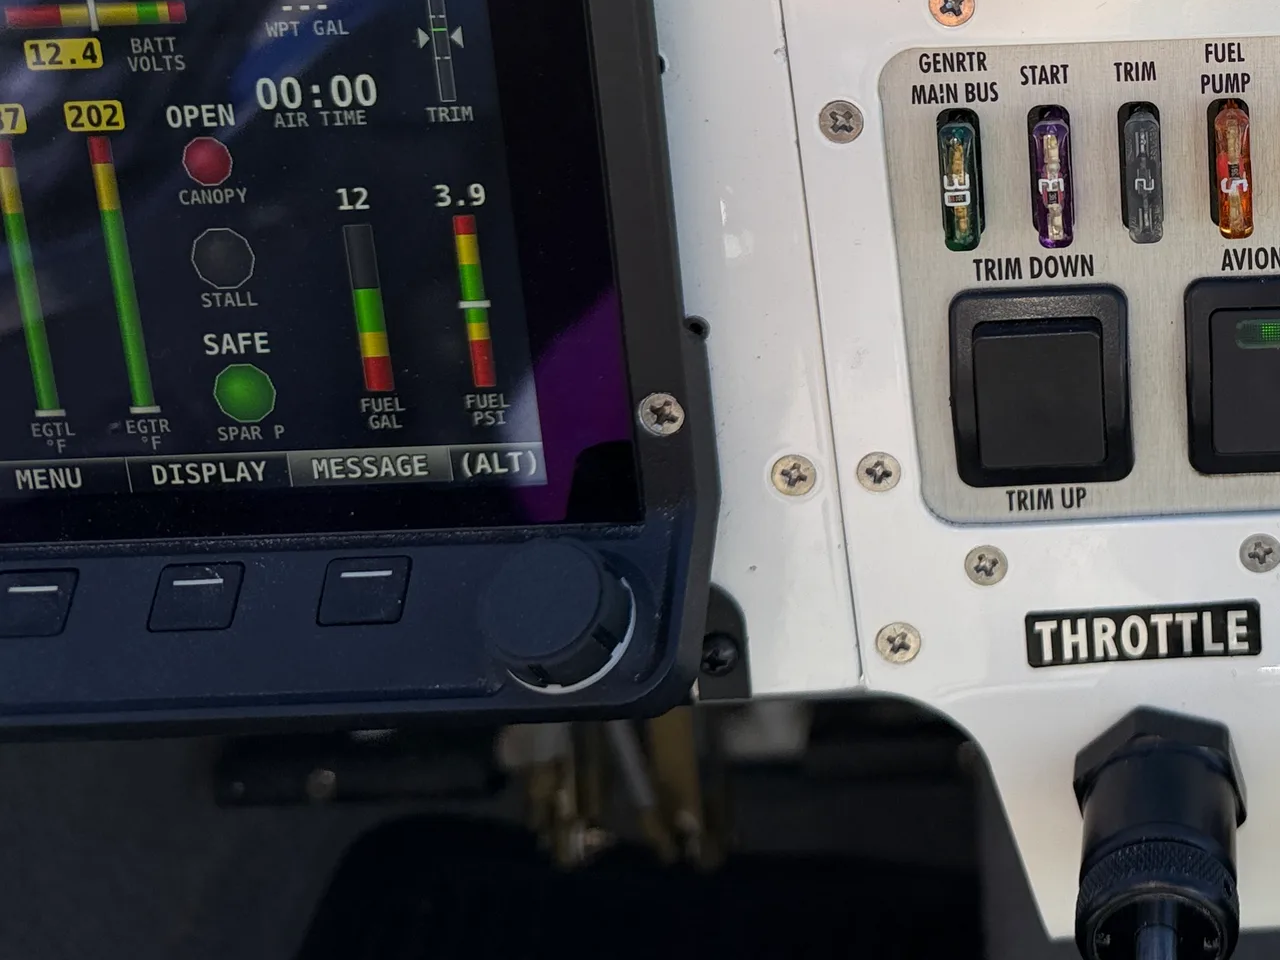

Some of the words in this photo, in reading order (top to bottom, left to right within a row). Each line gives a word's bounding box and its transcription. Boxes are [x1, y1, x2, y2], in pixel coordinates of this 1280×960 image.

[265, 21, 301, 38] WPT
[313, 19, 350, 36] GAL
[31, 43, 98, 66] 12.4
[131, 38, 176, 54] BATT
[1205, 42, 1245, 63] FUEL
[127, 55, 186, 73] VOLTS
[919, 51, 988, 74] GENRTR
[1114, 61, 1157, 82] TRIM
[1020, 64, 1069, 85] START
[1200, 72, 1251, 94] PUMP
[256, 74, 378, 110] 00:00
[911, 84, 959, 105] MAIN
[965, 81, 999, 103] BUS
[0, 107, 19, 131] 7
[68, 104, 120, 128] 202
[166, 103, 235, 128] OPEN
[274, 112, 309, 128] AIR
[319, 110, 367, 126] TIME
[427, 107, 474, 123] TRIM
[179, 189, 247, 205] CANOPY
[338, 188, 370, 210] 12
[434, 184, 486, 207] 3.9
[973, 257, 1022, 281] TRIM
[1029, 254, 1094, 278] DOWN
[201, 292, 258, 307] STALL
[203, 332, 270, 355] SAFE
[361, 397, 405, 413] FUEL
[466, 393, 510, 409] FUEL
[126, 420, 171, 435] EGTR
[369, 413, 402, 429] GAL
[473, 410, 507, 425] PSI
[31, 422, 75, 438] EGTL
[218, 426, 263, 441] SPAR
[274, 425, 285, 439] P
[152, 461, 267, 486] DISPLAY
[312, 454, 429, 479] MESSAGE
[461, 449, 538, 477] (ALT)
[15, 468, 82, 490] MENU
[1006, 489, 1054, 512] TRIM
[1061, 488, 1087, 509] UP
[1033, 610, 1249, 661] THROTTLE
